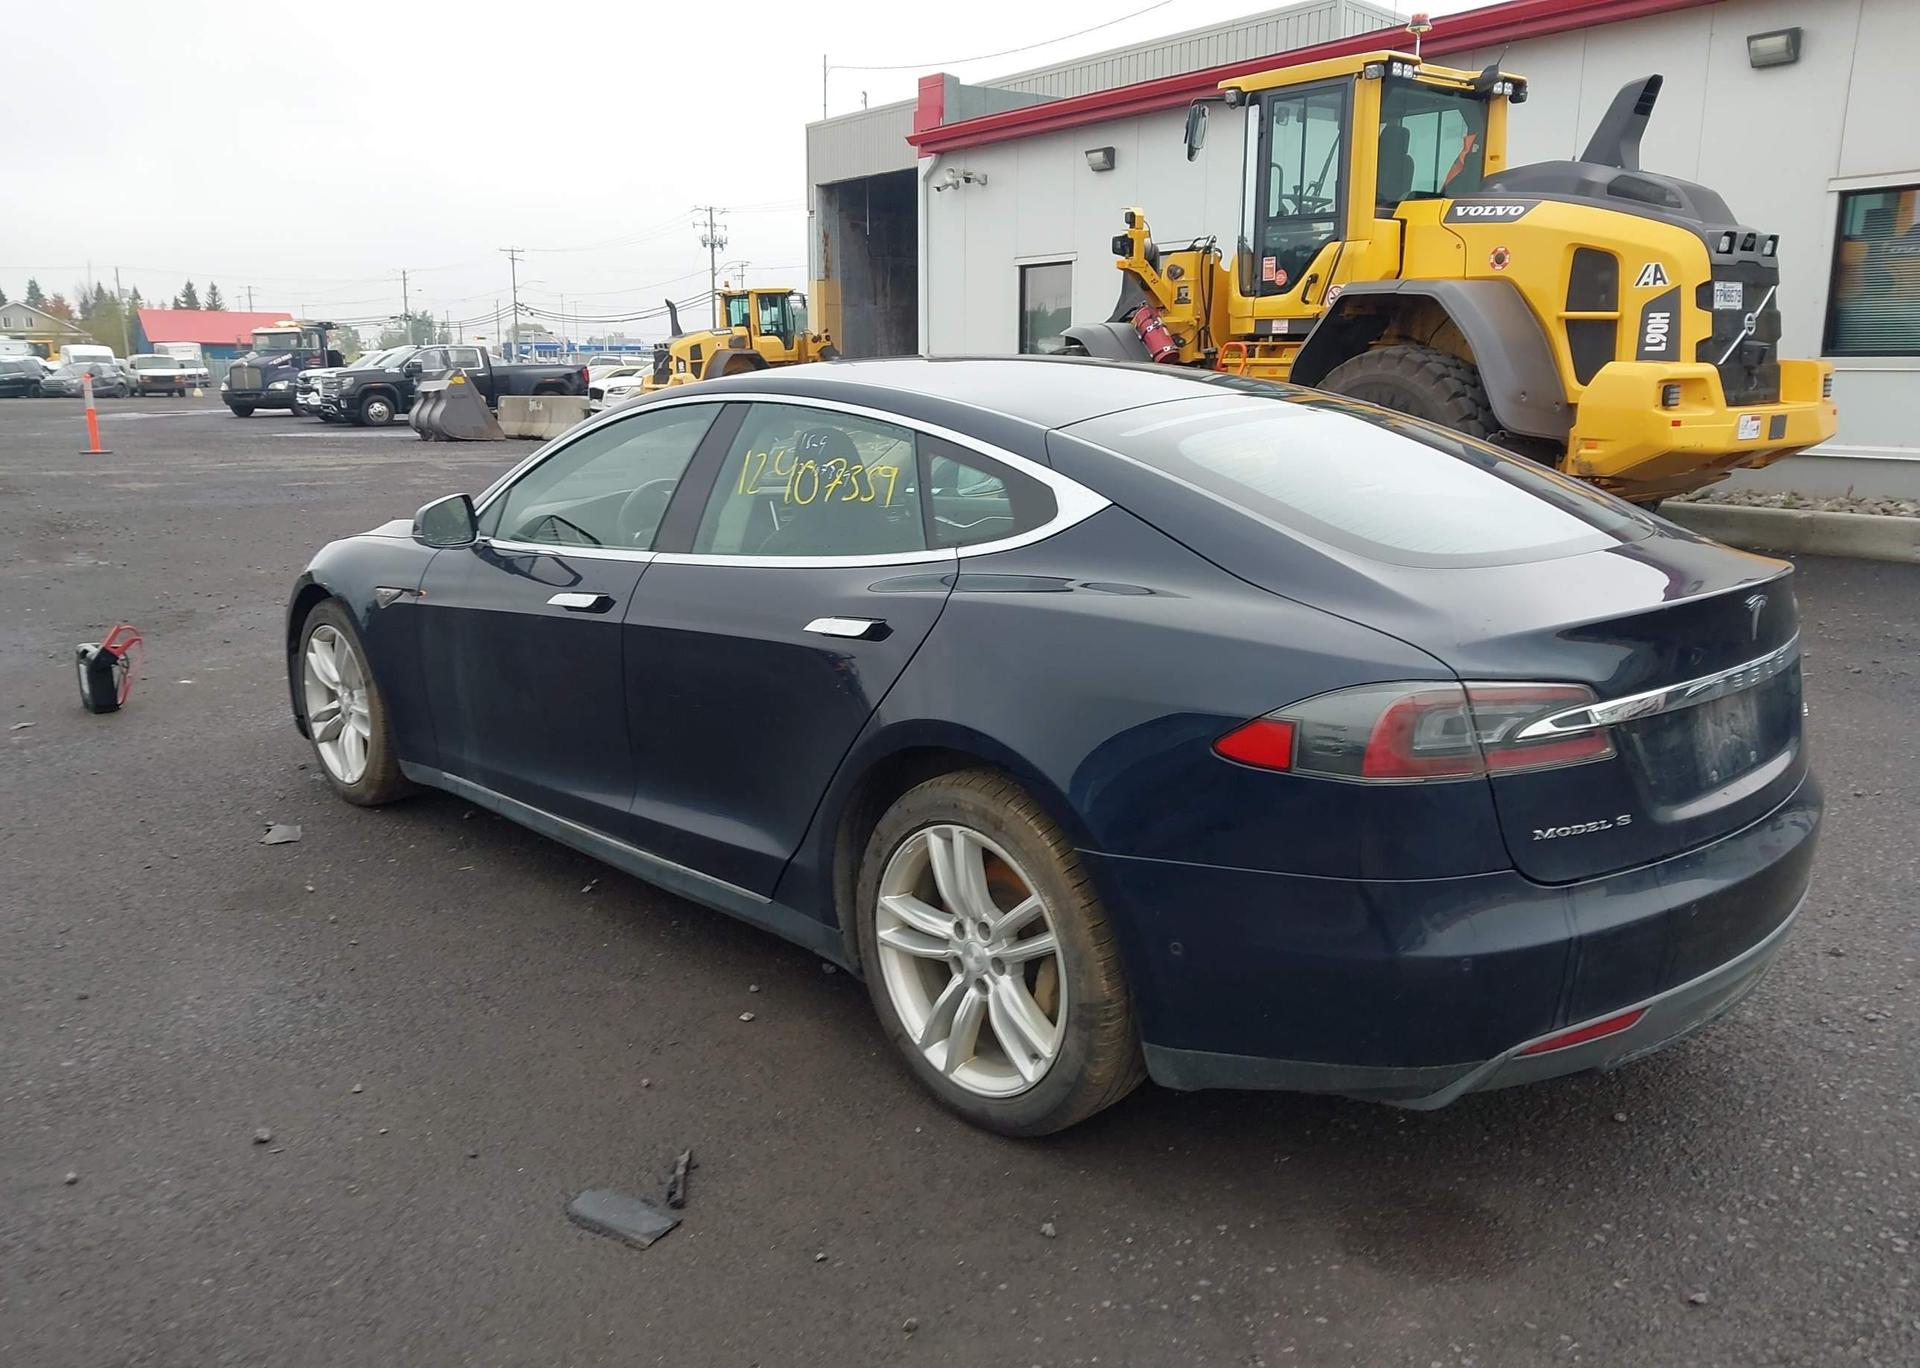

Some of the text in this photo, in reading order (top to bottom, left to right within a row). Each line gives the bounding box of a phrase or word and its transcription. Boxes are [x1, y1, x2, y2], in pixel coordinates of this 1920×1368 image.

[1455, 205, 1526, 217] VOLVO
[1644, 312, 1671, 352] L90H
[1532, 814, 1632, 841] MODEL S
